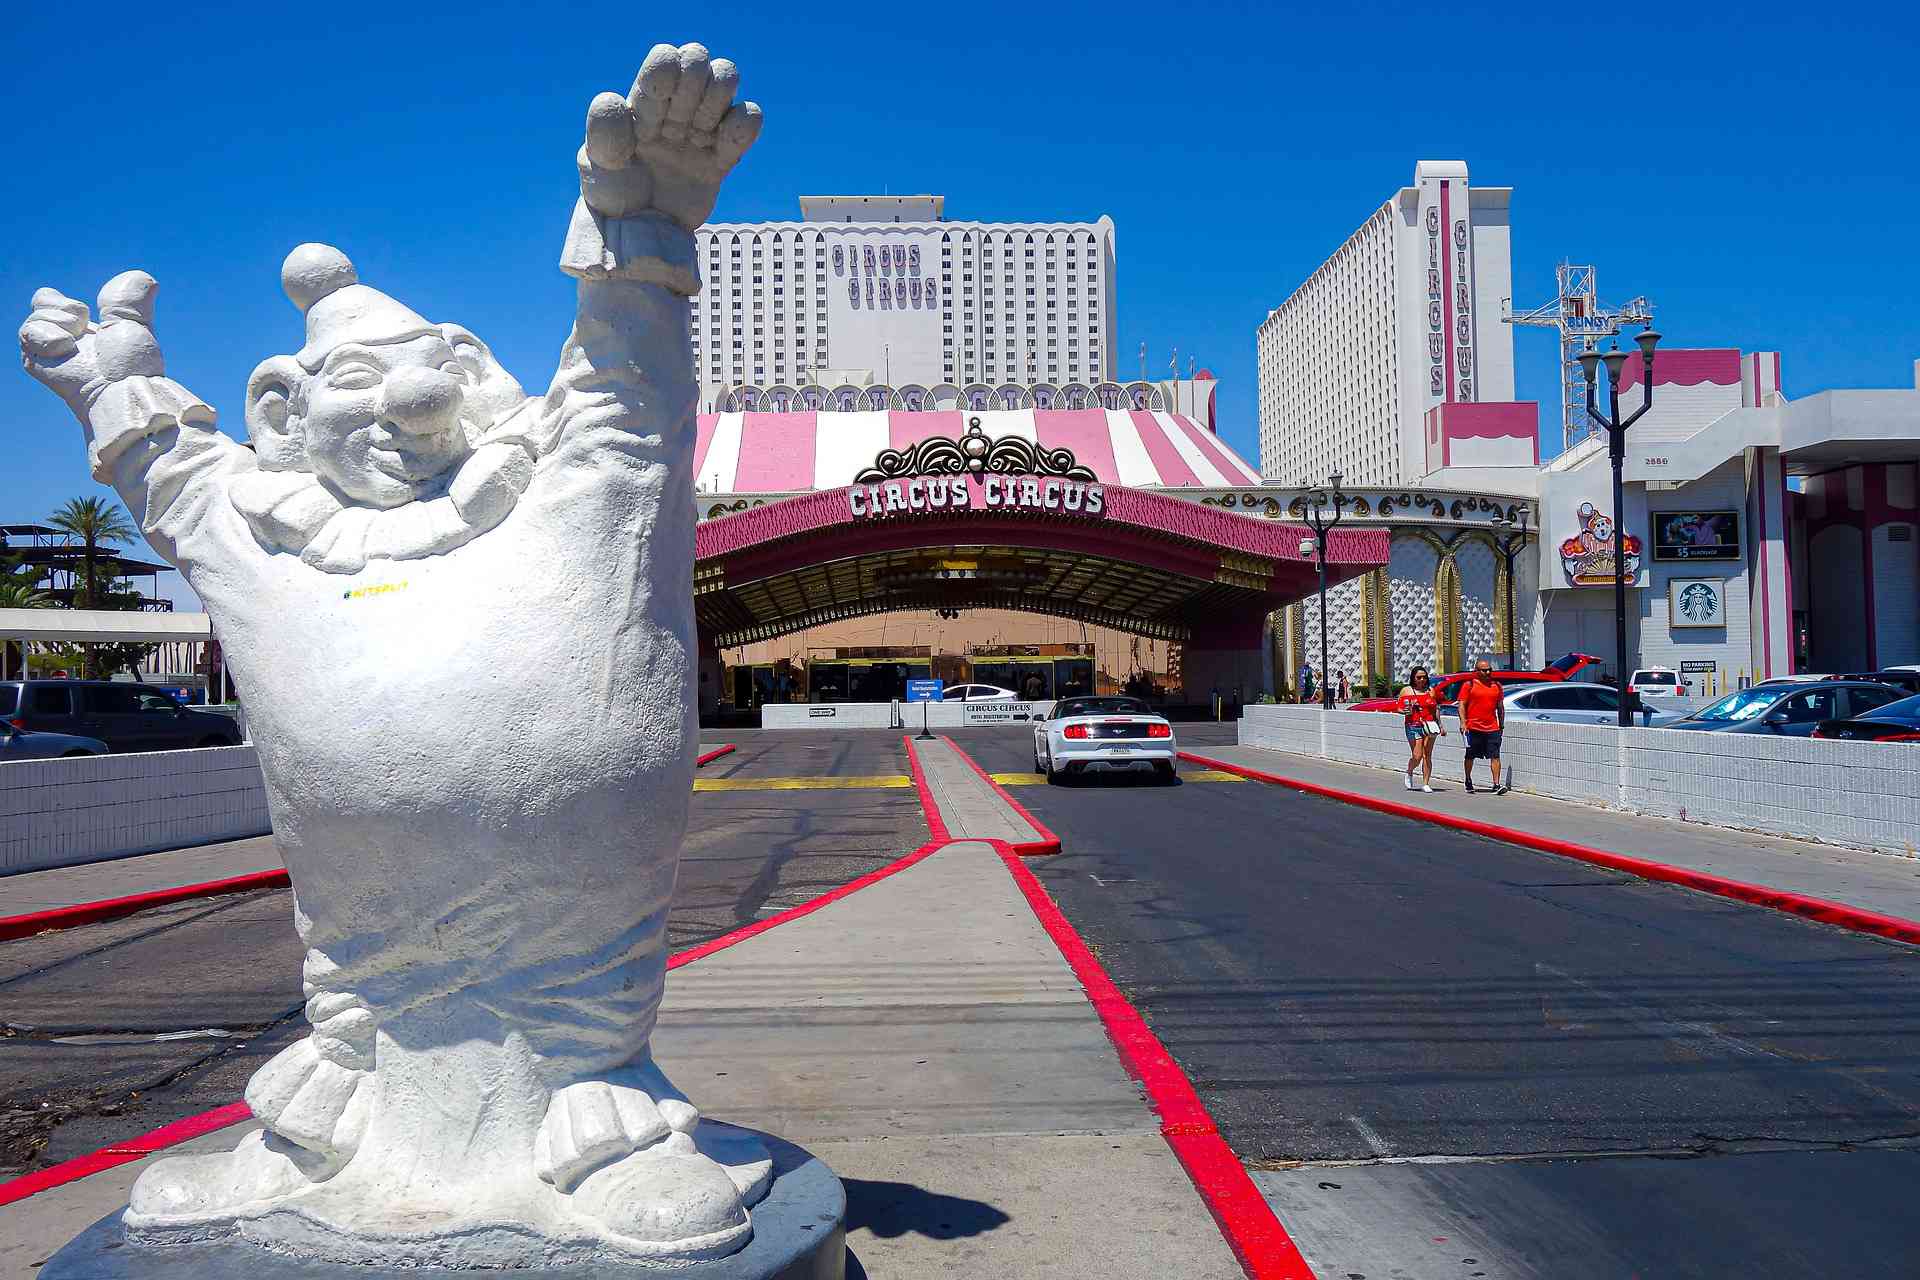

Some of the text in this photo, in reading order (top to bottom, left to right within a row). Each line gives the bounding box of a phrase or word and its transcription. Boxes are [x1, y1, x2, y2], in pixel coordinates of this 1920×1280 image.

[832, 244, 920, 271] CIRCUS
[848, 278, 937, 304] CIRCUS
[1426, 206, 1443, 396] CIRCUS
[1454, 220, 1472, 402] CIRCUS
[850, 475, 1103, 516] CIRCUS CIRCUS
[966, 704, 1031, 712] CIRCUS CIRCUS
